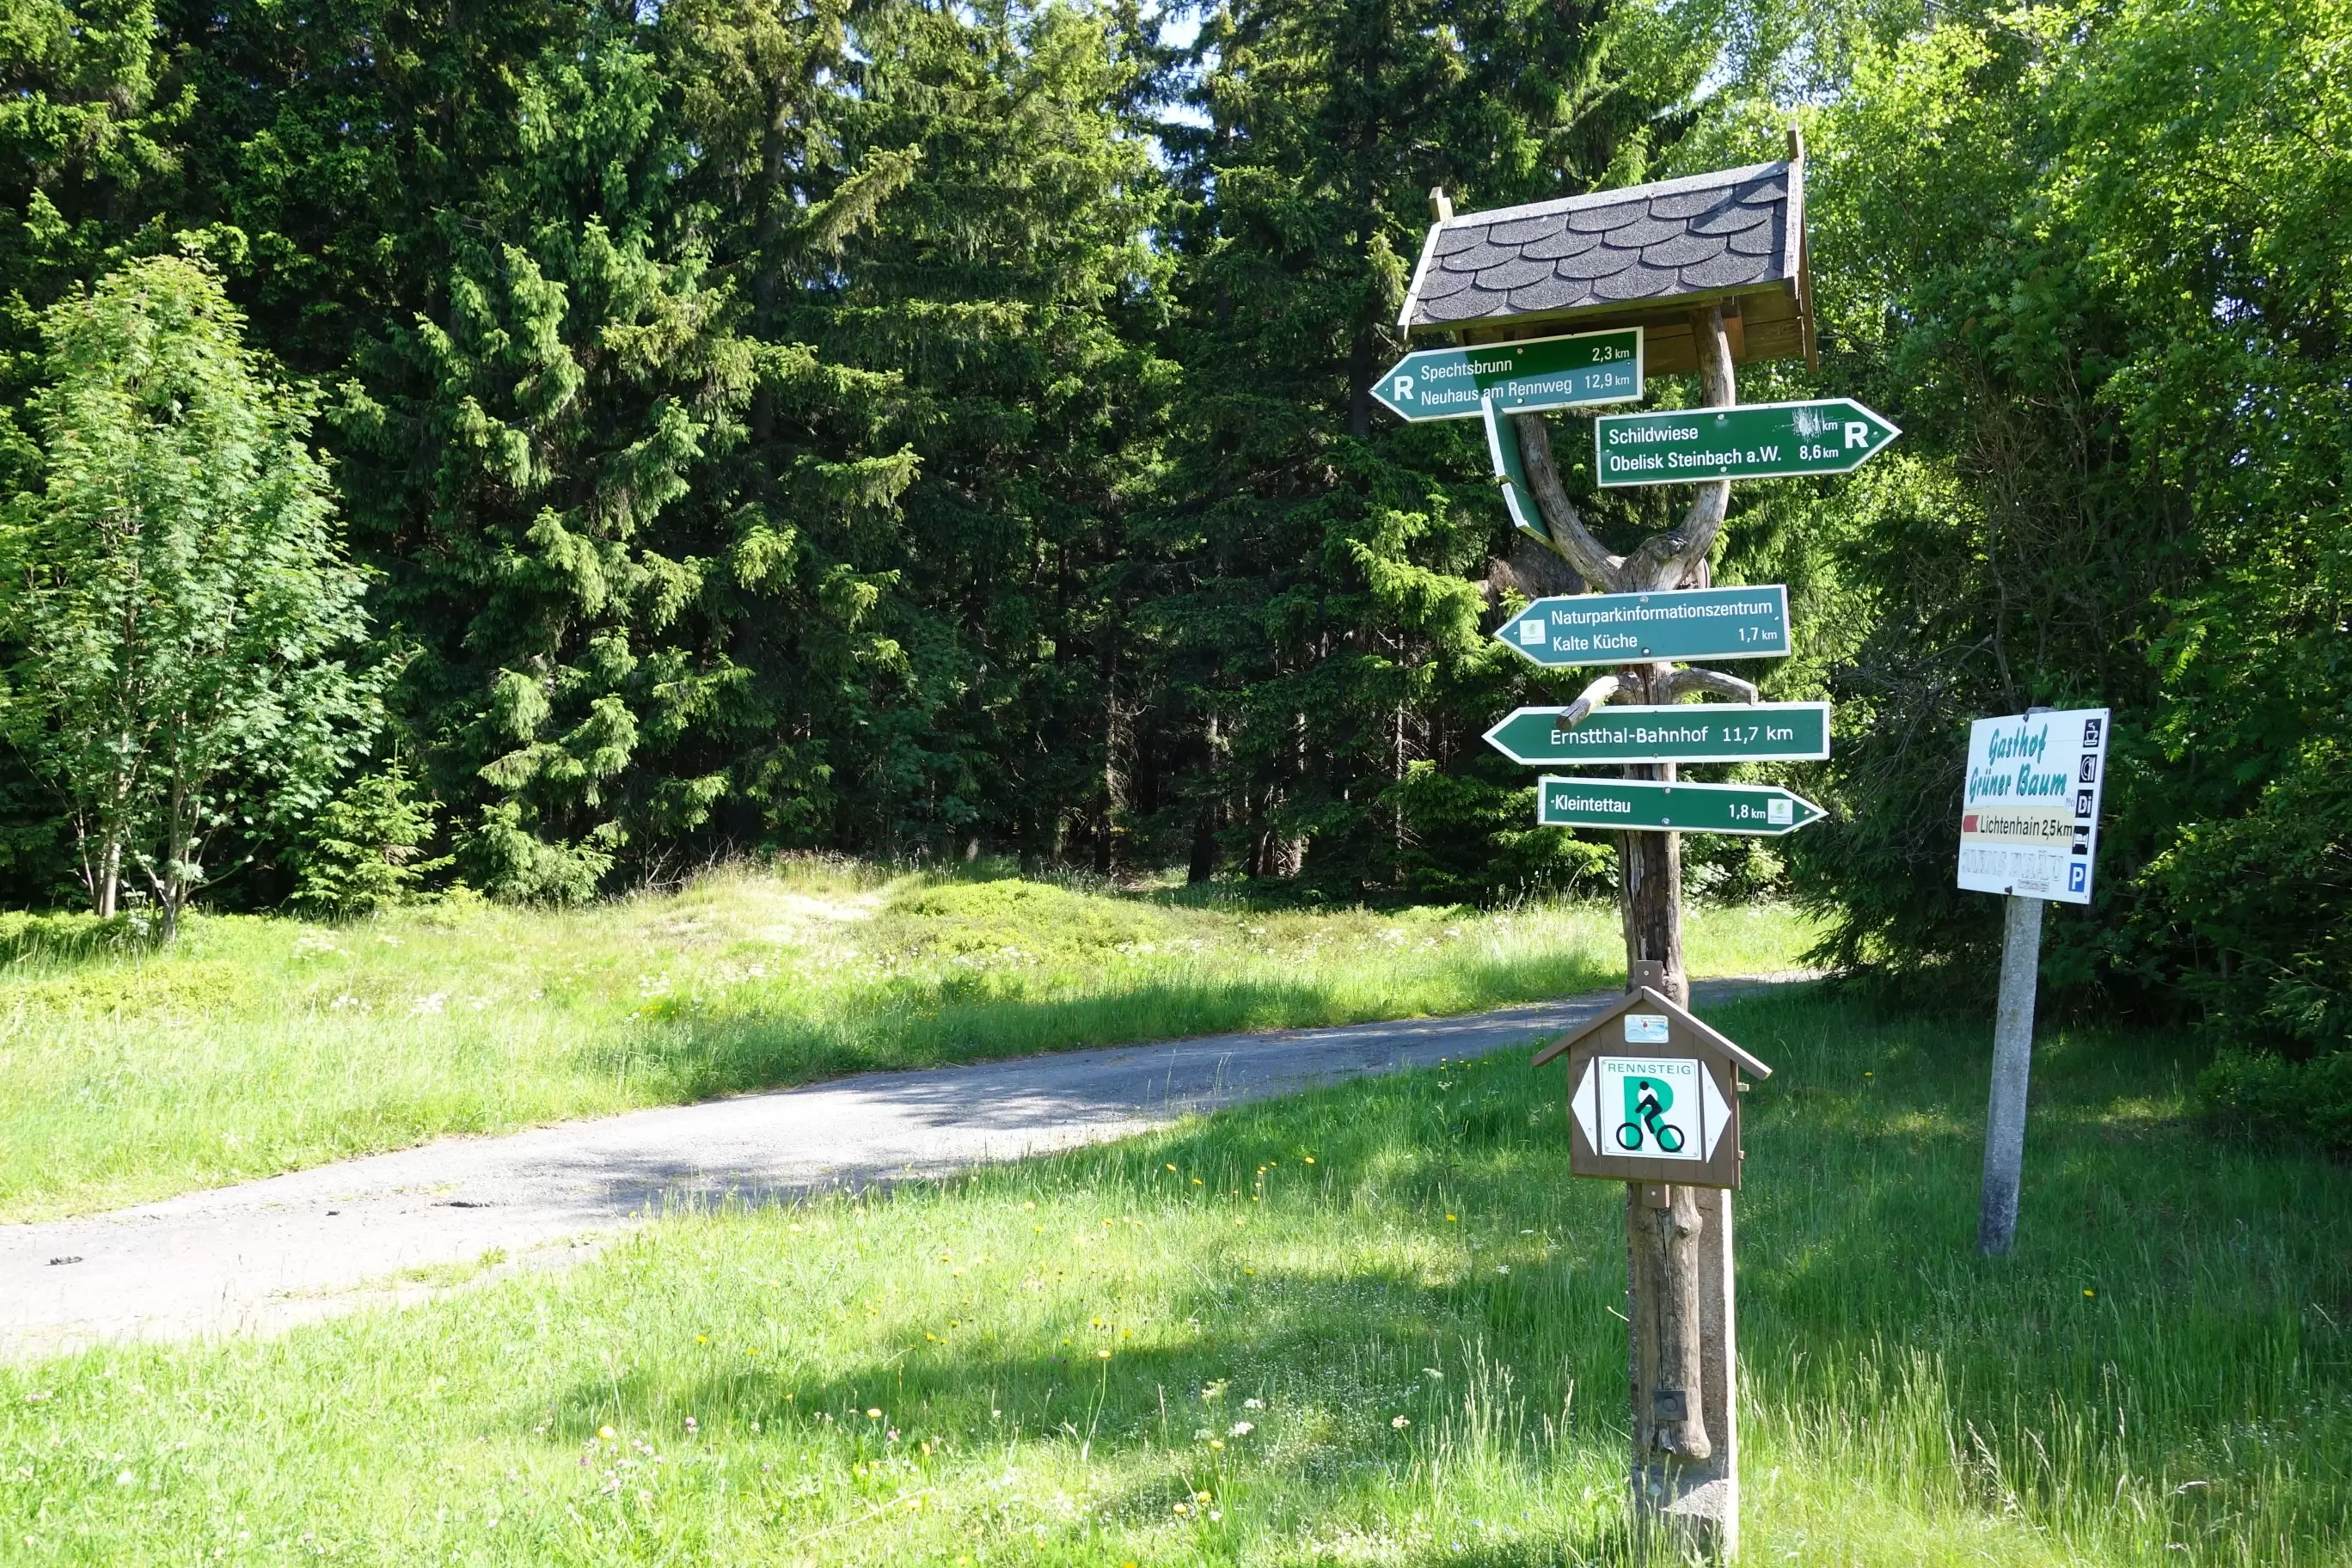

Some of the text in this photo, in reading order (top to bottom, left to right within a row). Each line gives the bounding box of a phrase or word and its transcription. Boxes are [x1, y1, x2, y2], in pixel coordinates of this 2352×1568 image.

[1421, 347, 1630, 383] Spechtsbrunn 2,3 km
[1393, 376, 1414, 401] R
[1421, 373, 1630, 407] Neuhaus am Rennweg 12,9 km
[1609, 426, 1699, 444] Schildwiese
[1822, 420, 1838, 431] km
[1845, 421, 1869, 449] R
[1610, 444, 1839, 472] Obelisk Steinbach a.W. 8,6 km
[1551, 602, 1773, 627] Naturparkinformationszentrum
[1553, 635, 1589, 652] Kalte
[1594, 632, 1638, 650] Küche
[1738, 628, 1758, 643] 1,7
[1762, 629, 1778, 640] km
[1551, 726, 1793, 745] Ernstthal-Bahnhof 11,7 km
[1988, 723, 2049, 766] Gasthof
[1969, 763, 2067, 804] Grüner Baum
[1554, 794, 1631, 813] Kleintettau
[1729, 804, 1749, 820] 1,8
[1751, 808, 1766, 819] km
[1980, 815, 2040, 836] Lichtenhain
[2072, 867, 2084, 890] P
[1608, 1063, 1691, 1075] RENNSTEIG
